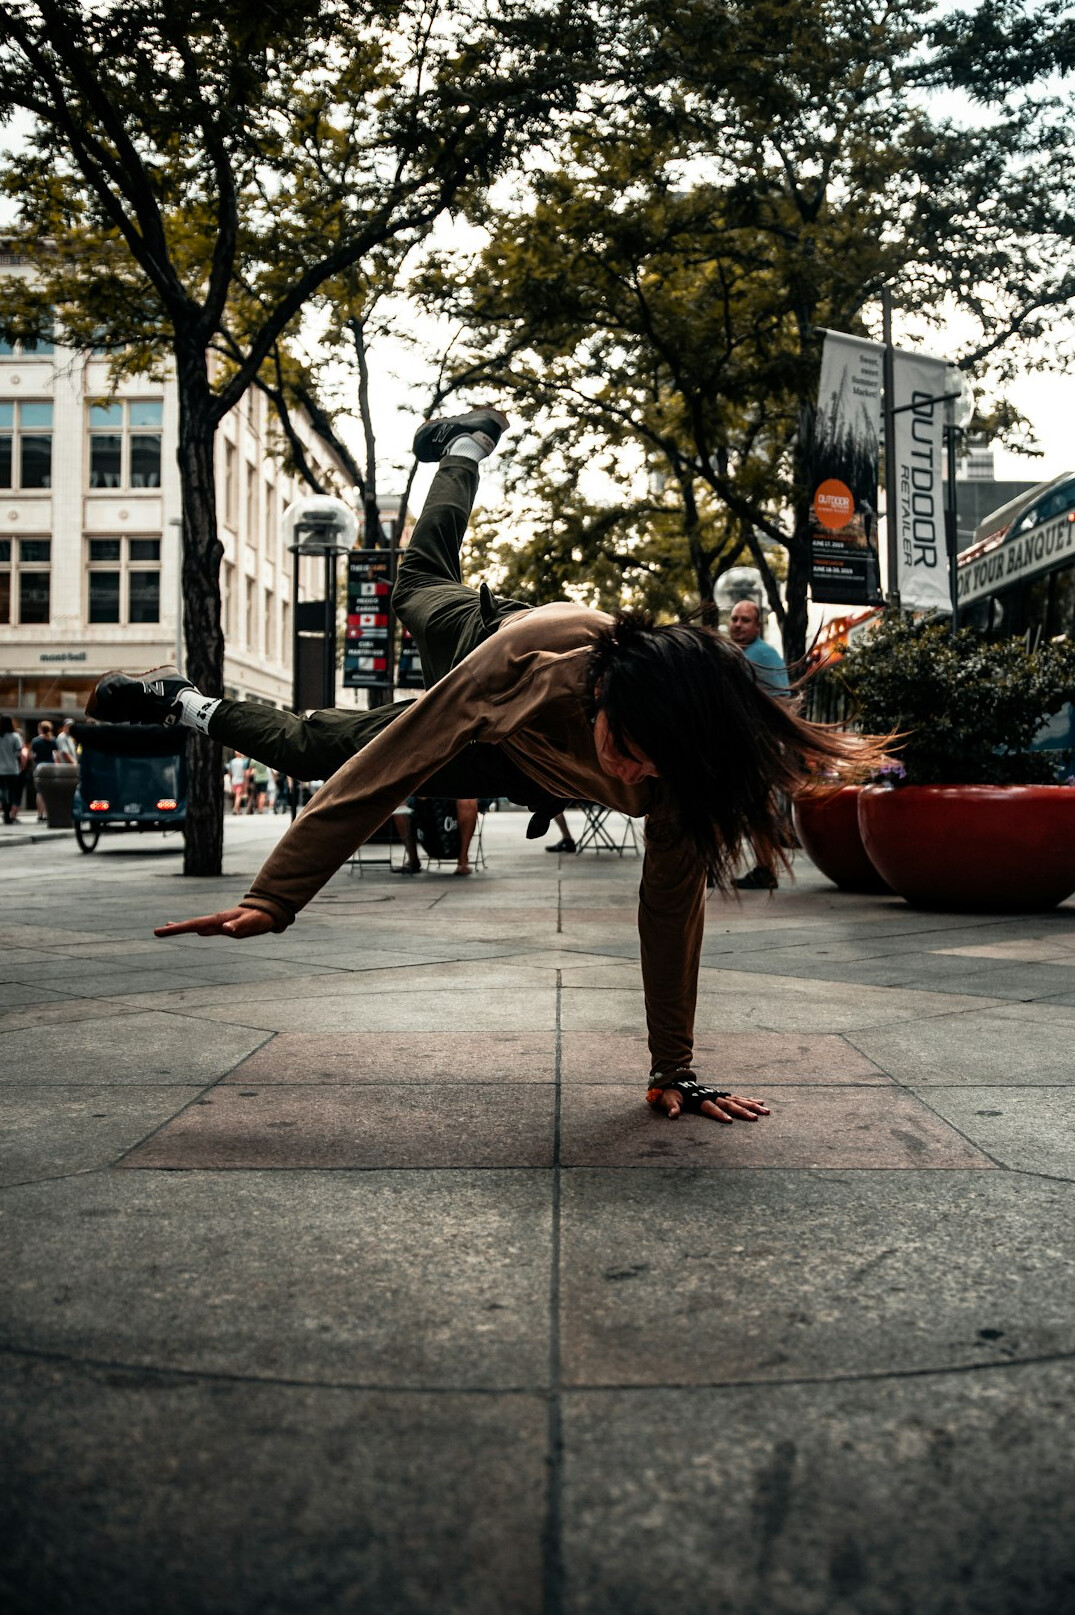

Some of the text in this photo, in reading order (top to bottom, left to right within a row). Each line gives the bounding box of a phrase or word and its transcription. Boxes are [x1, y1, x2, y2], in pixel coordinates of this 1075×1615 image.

[818, 494, 849, 505] OUTDOOR
[901, 464, 912, 567] RETAILER
[911, 390, 937, 568] OUTDOOR
[973, 555, 1005, 591] YOUR
[1007, 518, 1073, 575] BANQUET
